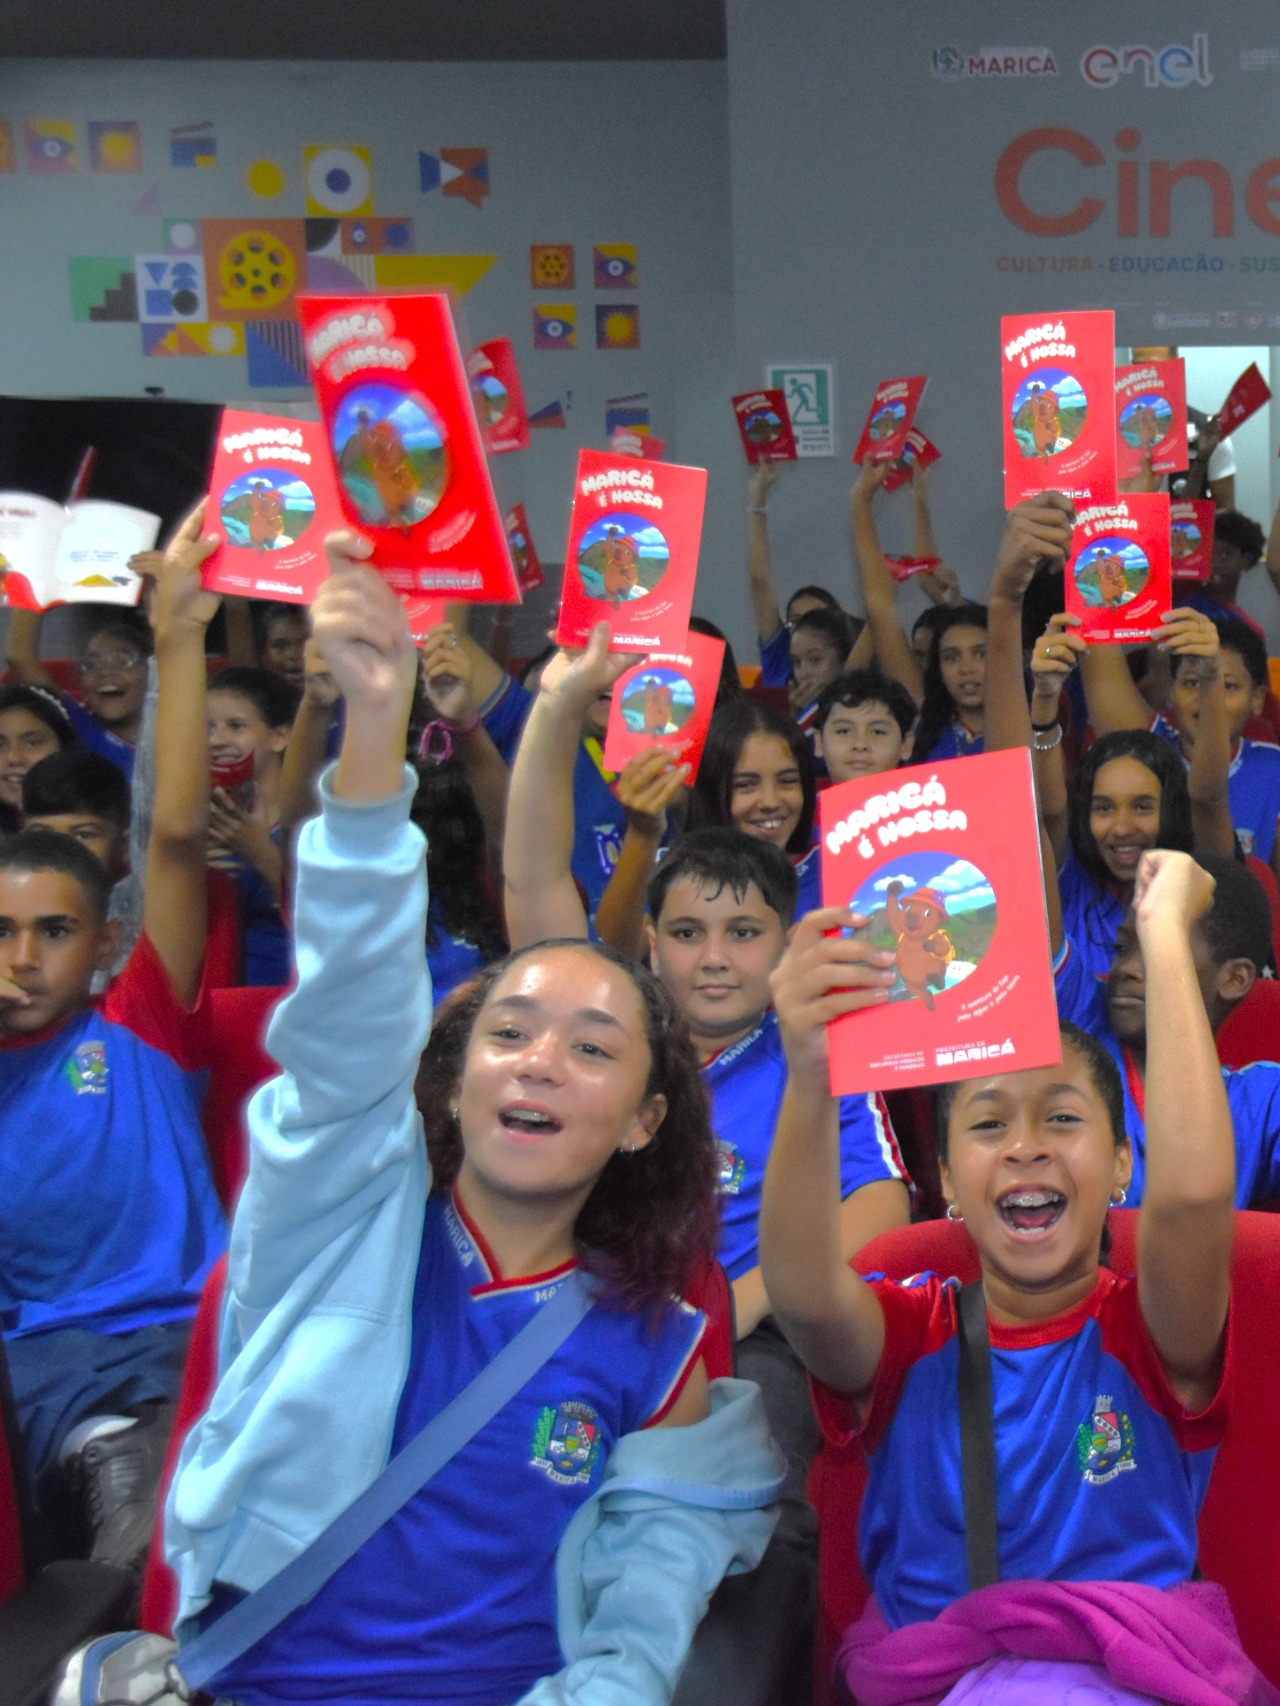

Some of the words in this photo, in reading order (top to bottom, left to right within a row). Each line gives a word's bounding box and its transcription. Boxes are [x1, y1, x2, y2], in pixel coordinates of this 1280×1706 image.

[1083, 35, 1213, 87] enel
[997, 256, 1093, 273] CULTURA
[1005, 321, 1066, 362] MARICÁ
[1020, 351, 1028, 368] É
[1030, 342, 1076, 362] NOSSA
[581, 469, 655, 496] MARICÁ
[599, 491, 608, 507] É
[611, 489, 663, 510] NOSSA
[1094, 517, 1138, 532] NOSSA
[826, 775, 946, 855] MARICÁ
[858, 834, 875, 858] É
[877, 809, 968, 847] NOSSA
[935, 1043, 975, 1053] PREFEITURA
[935, 1038, 1016, 1067] MARICÁ
